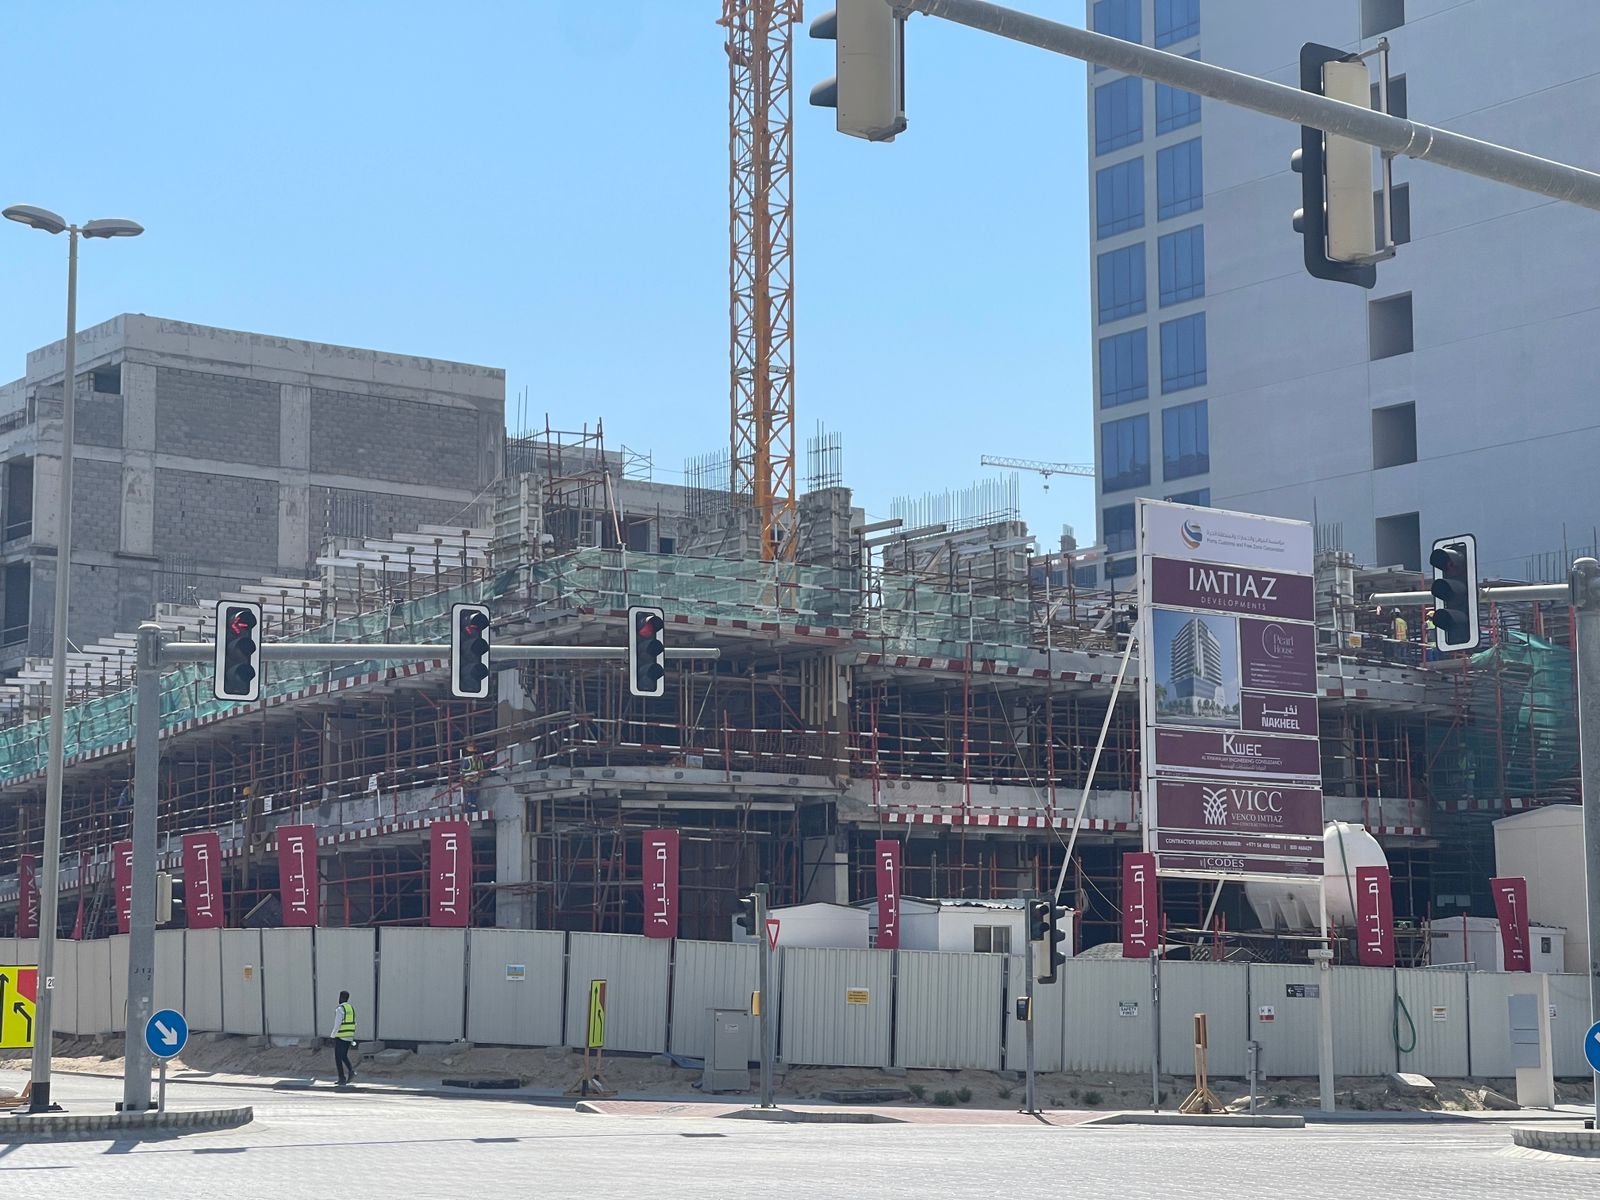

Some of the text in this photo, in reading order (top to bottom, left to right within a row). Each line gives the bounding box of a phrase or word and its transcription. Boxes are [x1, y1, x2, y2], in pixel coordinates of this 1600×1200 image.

[1189, 567, 1277, 600] IMTIAZ
[1201, 596, 1266, 611] DEVELOPMENTS
[1261, 717, 1300, 730] NAKHEEL
[1231, 789, 1282, 812] VICC
[1231, 813, 1283, 823] VENCO IMTIAZ
[1207, 857, 1244, 868] CODES
